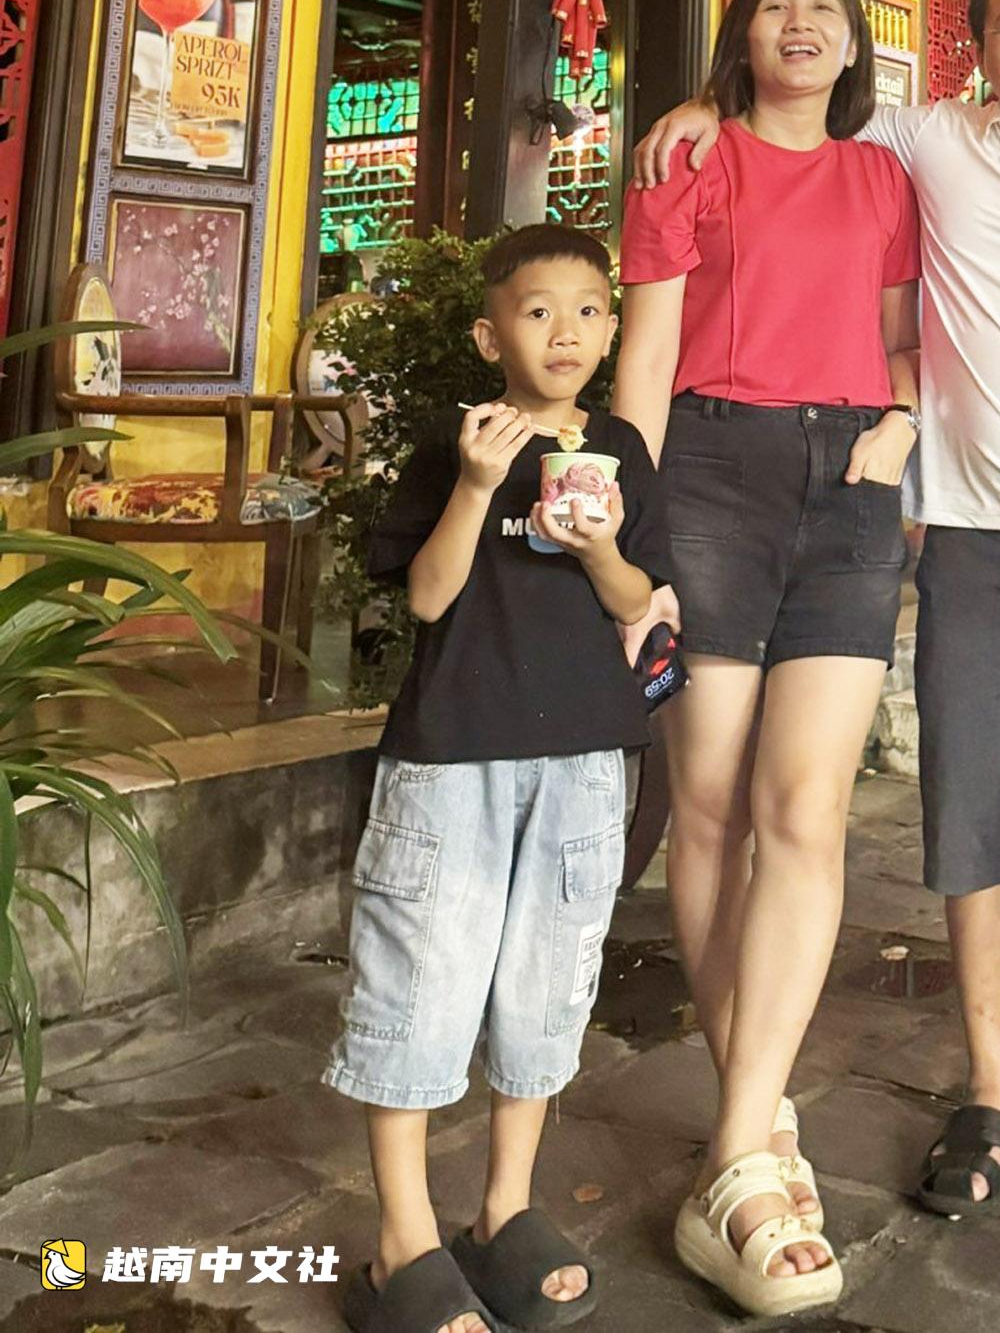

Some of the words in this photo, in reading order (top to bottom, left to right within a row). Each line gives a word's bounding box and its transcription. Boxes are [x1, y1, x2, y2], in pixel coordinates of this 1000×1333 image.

[176, 35, 248, 64] APEROL
[176, 55, 236, 81] SPRIZT
[201, 82, 242, 109] 95K
[645, 667, 675, 698] 20:59
